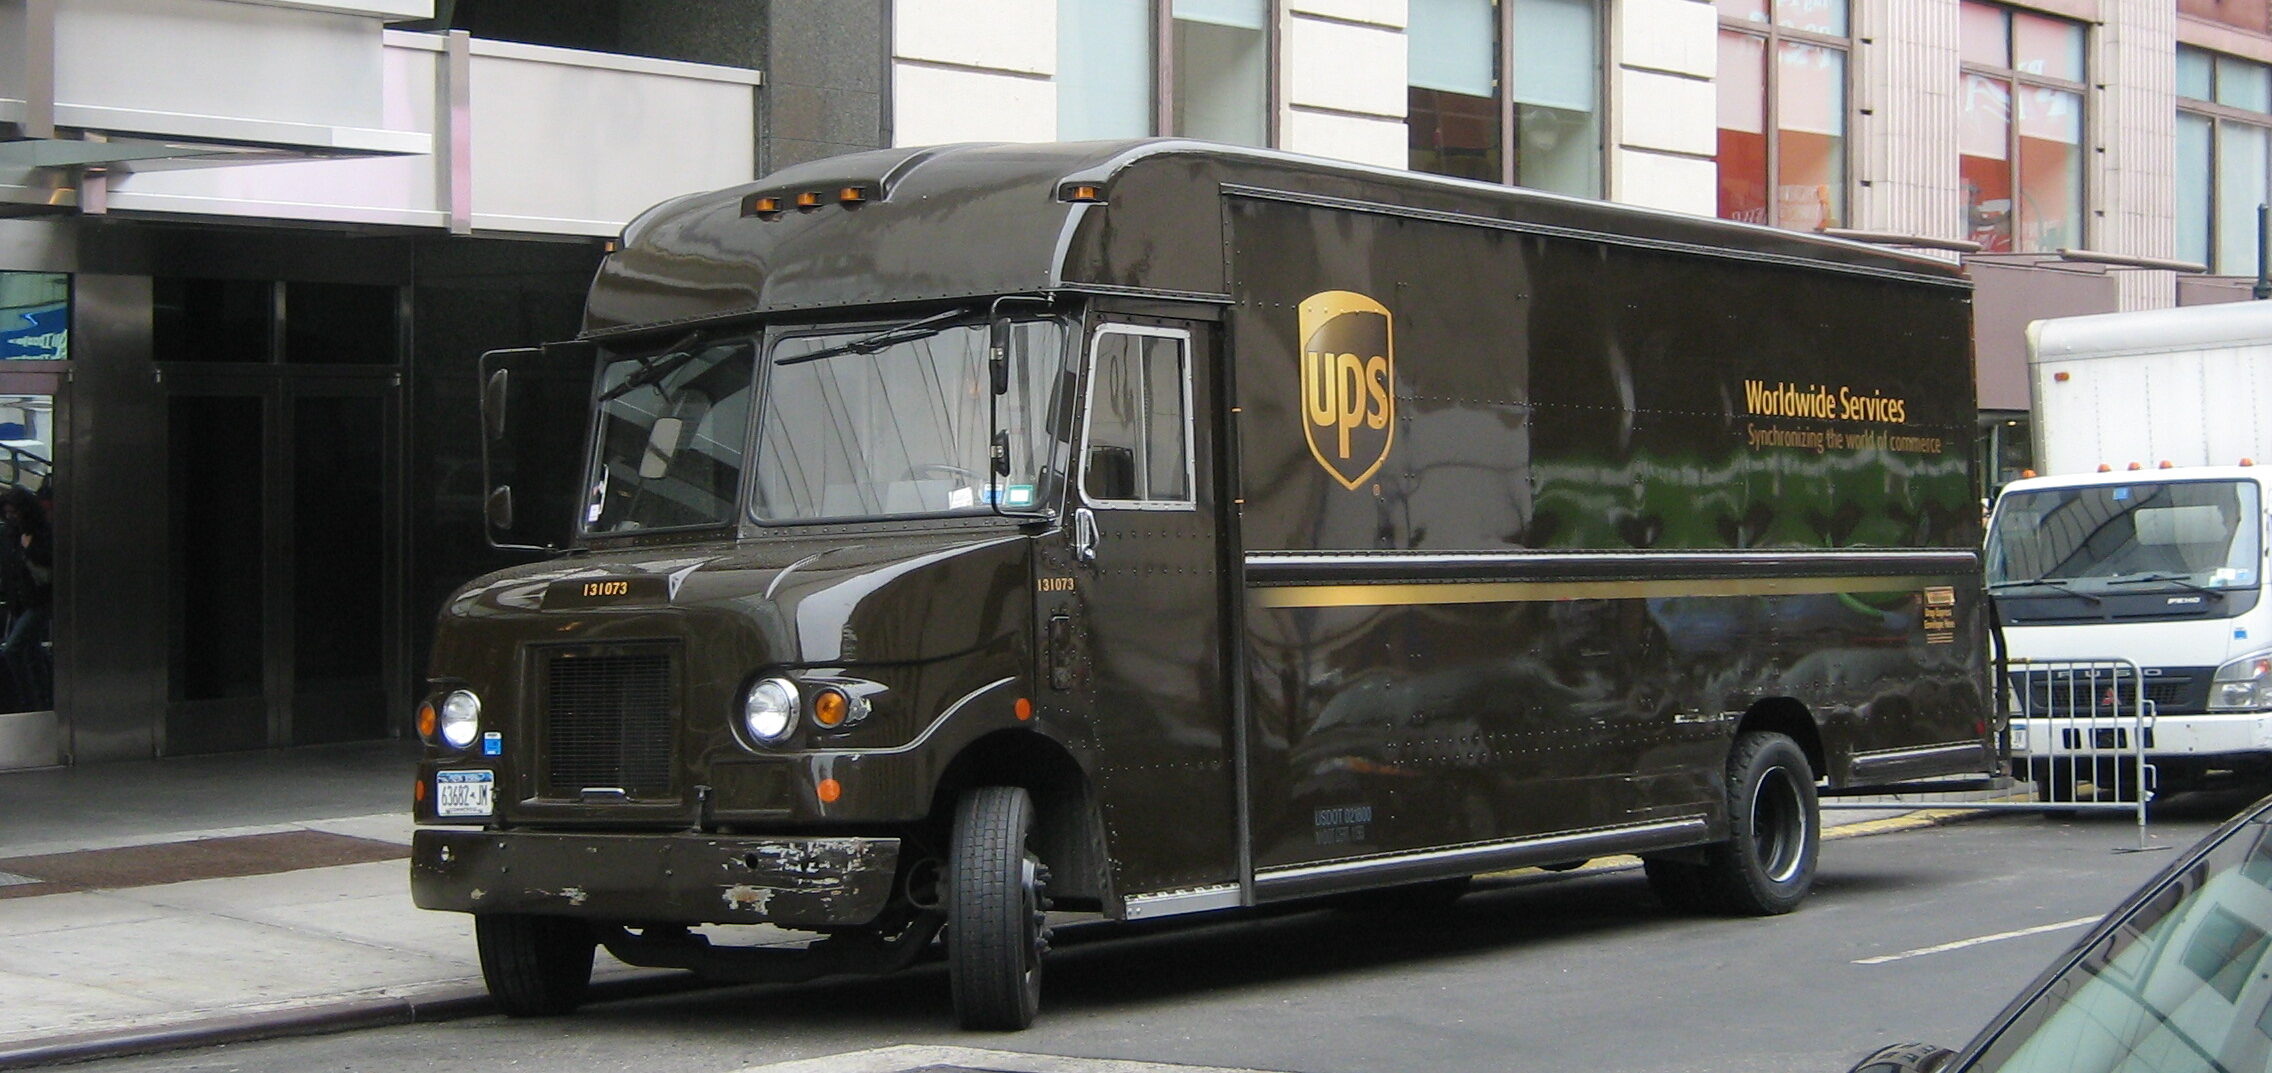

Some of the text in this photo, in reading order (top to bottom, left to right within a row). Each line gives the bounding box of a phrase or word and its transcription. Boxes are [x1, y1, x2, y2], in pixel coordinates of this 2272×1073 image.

[1744, 379, 1906, 424] Worldwide Services
[1748, 422, 1942, 454] Synchronizing the world of commerce
[583, 581, 628, 597] 131073
[1037, 577, 1075, 592] 131073
[2057, 668, 2163, 679] FUSO
[1315, 808, 1343, 826] USDOT
